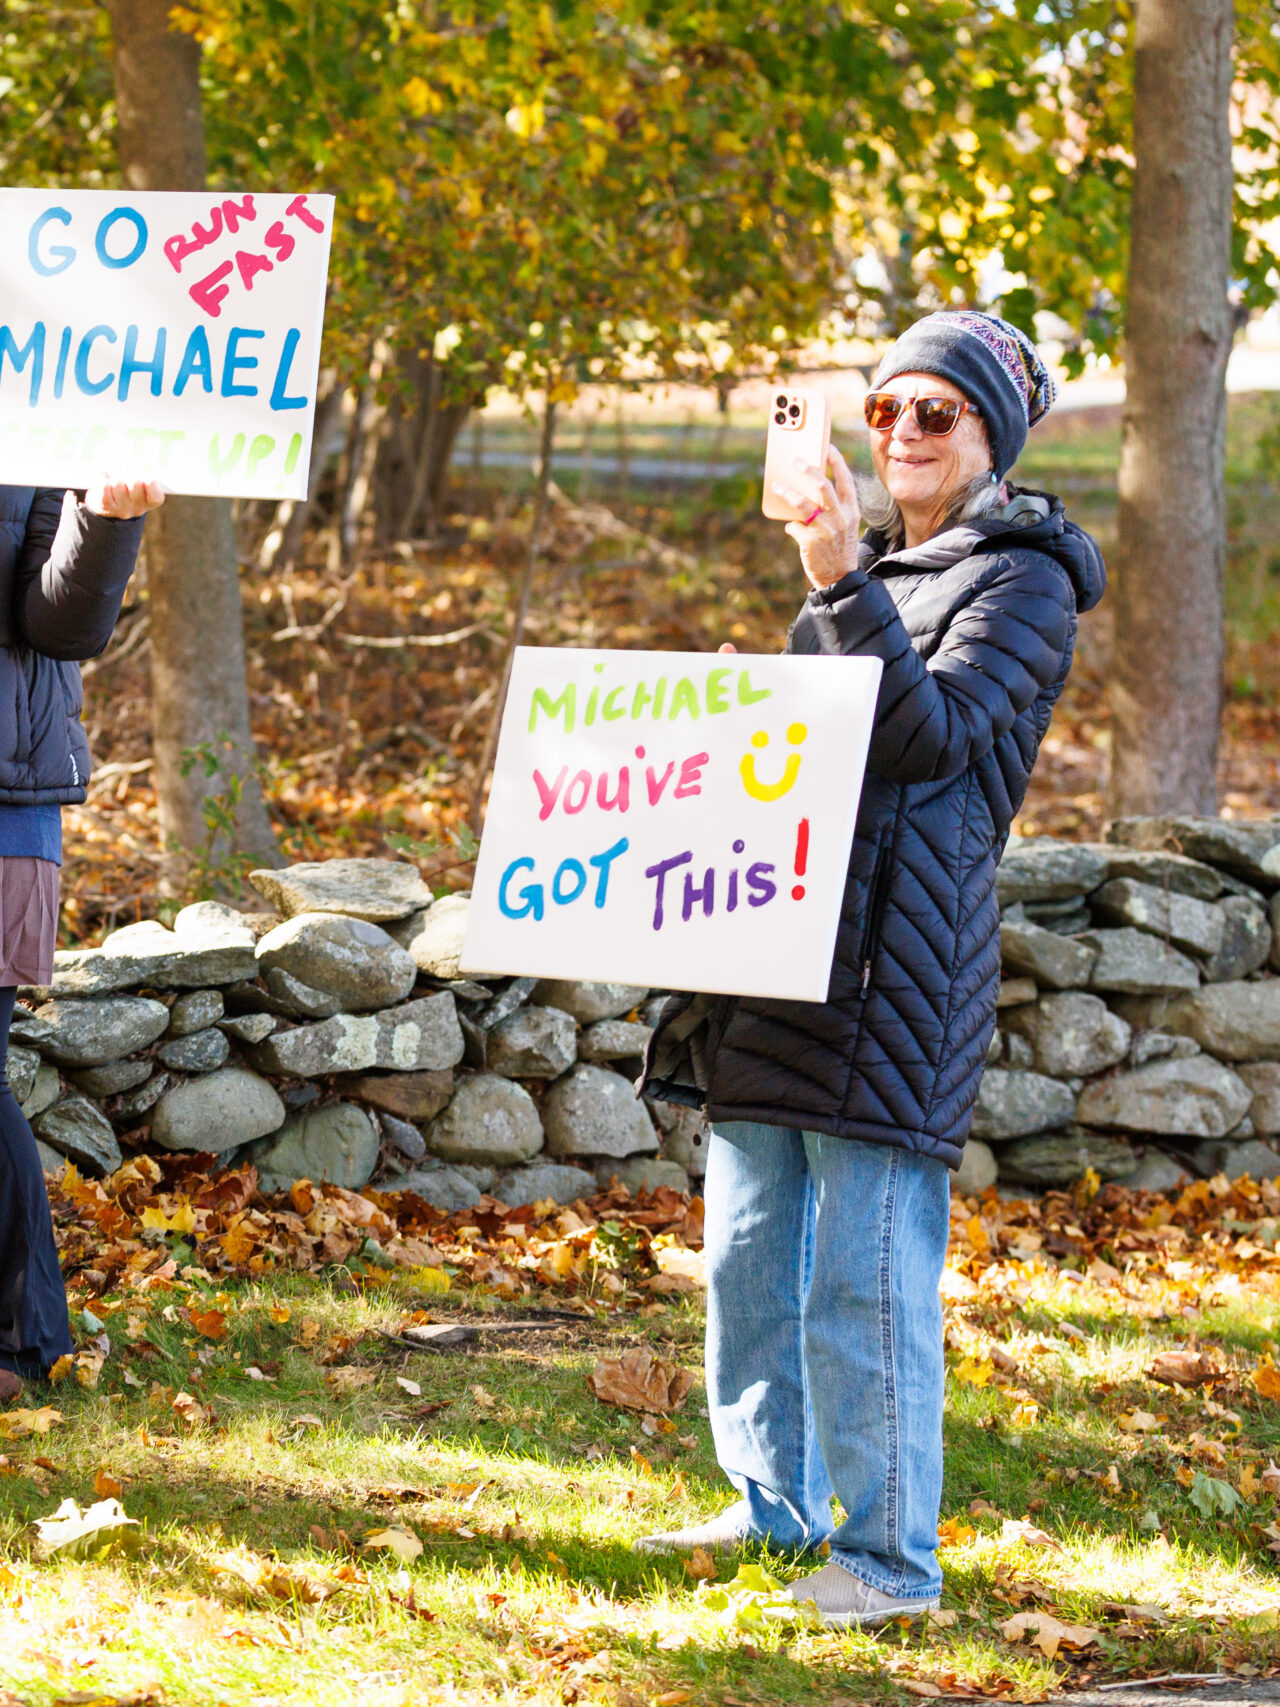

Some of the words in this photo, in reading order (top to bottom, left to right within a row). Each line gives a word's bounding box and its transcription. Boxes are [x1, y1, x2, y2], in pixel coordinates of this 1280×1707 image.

[28, 206, 148, 277] GO
[163, 194, 257, 273] RUN
[188, 195, 325, 317] FAST
[126, 427, 187, 473] IT
[208, 431, 304, 493] UP!
[498, 837, 630, 922] GOT
